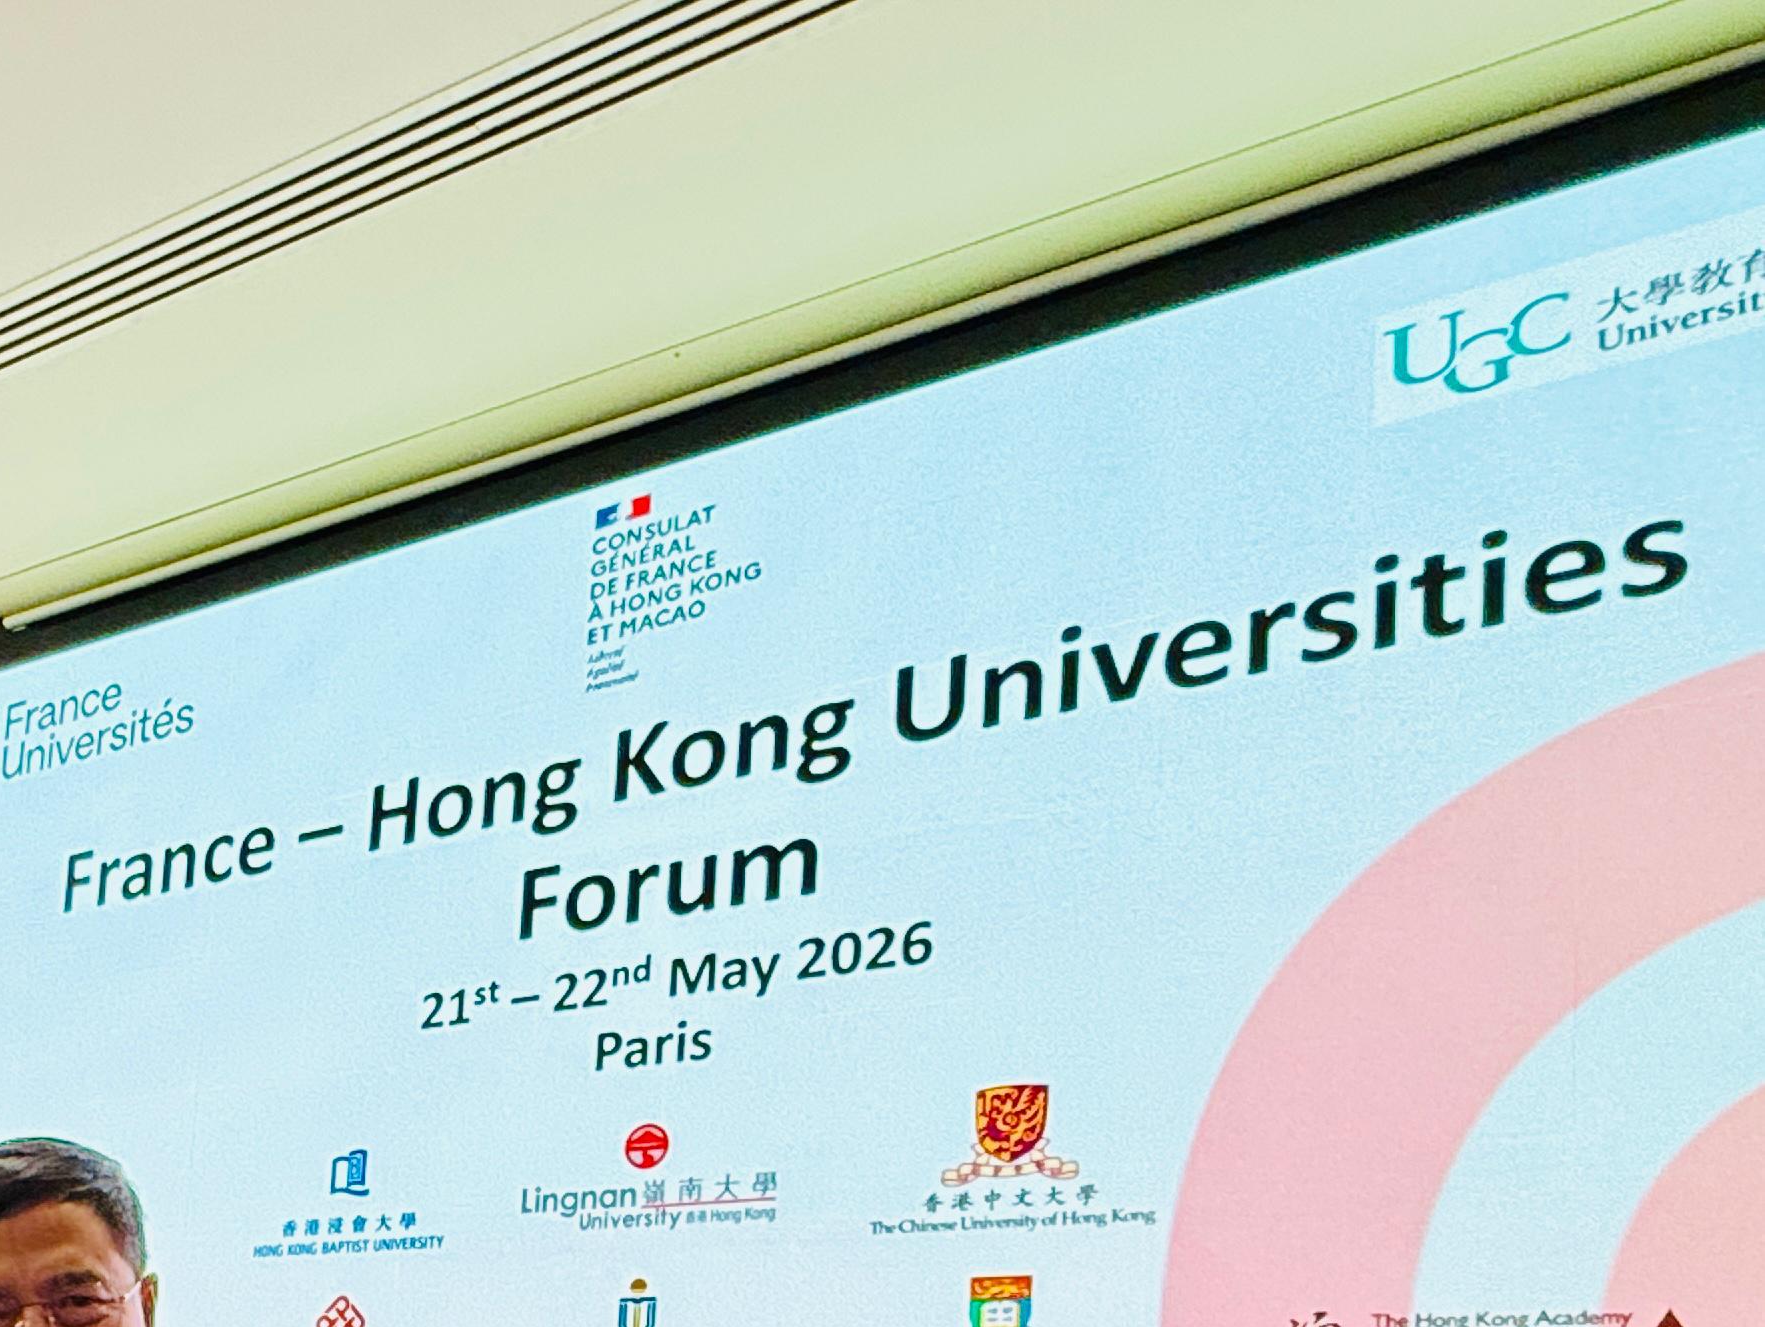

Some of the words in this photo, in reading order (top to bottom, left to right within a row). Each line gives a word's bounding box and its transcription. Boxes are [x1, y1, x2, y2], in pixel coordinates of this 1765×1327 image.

[1383, 292, 1572, 394] UGC
[1598, 291, 1765, 351] Universit
[592, 505, 716, 555] CONSULAT
[590, 577, 618, 601] DE
[625, 550, 717, 591] FRANCE
[591, 535, 696, 577] GÉNÉRAL
[610, 583, 682, 617] HONG
[690, 561, 762, 596] KONG
[587, 624, 613, 645] ET
[619, 600, 706, 638] MACAO
[5, 683, 123, 741] France
[62, 818, 275, 913] France
[368, 756, 582, 853] Hong
[613, 696, 856, 802] Kong
[895, 515, 1689, 742] Universities
[2, 697, 195, 779] Universités
[517, 833, 820, 940] Forum
[420, 980, 501, 1029] 21st
[552, 954, 652, 1012] 22nd
[668, 951, 781, 998] May
[797, 920, 933, 981] 2026
[595, 1020, 713, 1072] Paris
[521, 1187, 636, 1218] Lingnan
[579, 1207, 681, 1230] University
[711, 1209, 741, 1224] Hong
[745, 1207, 776, 1222] Kong
[870, 1221, 895, 1235] The
[898, 1218, 957, 1234] Chinese
[961, 1214, 1039, 1231] University
[1041, 1211, 1058, 1226] of
[1062, 1210, 1107, 1228] Hong
[1111, 1208, 1156, 1225] Kong
[253, 1244, 283, 1258] HONG
[287, 1242, 317, 1256] KONG
[322, 1239, 370, 1254] BAPTIST
[373, 1235, 444, 1251] UNIVERSITY
